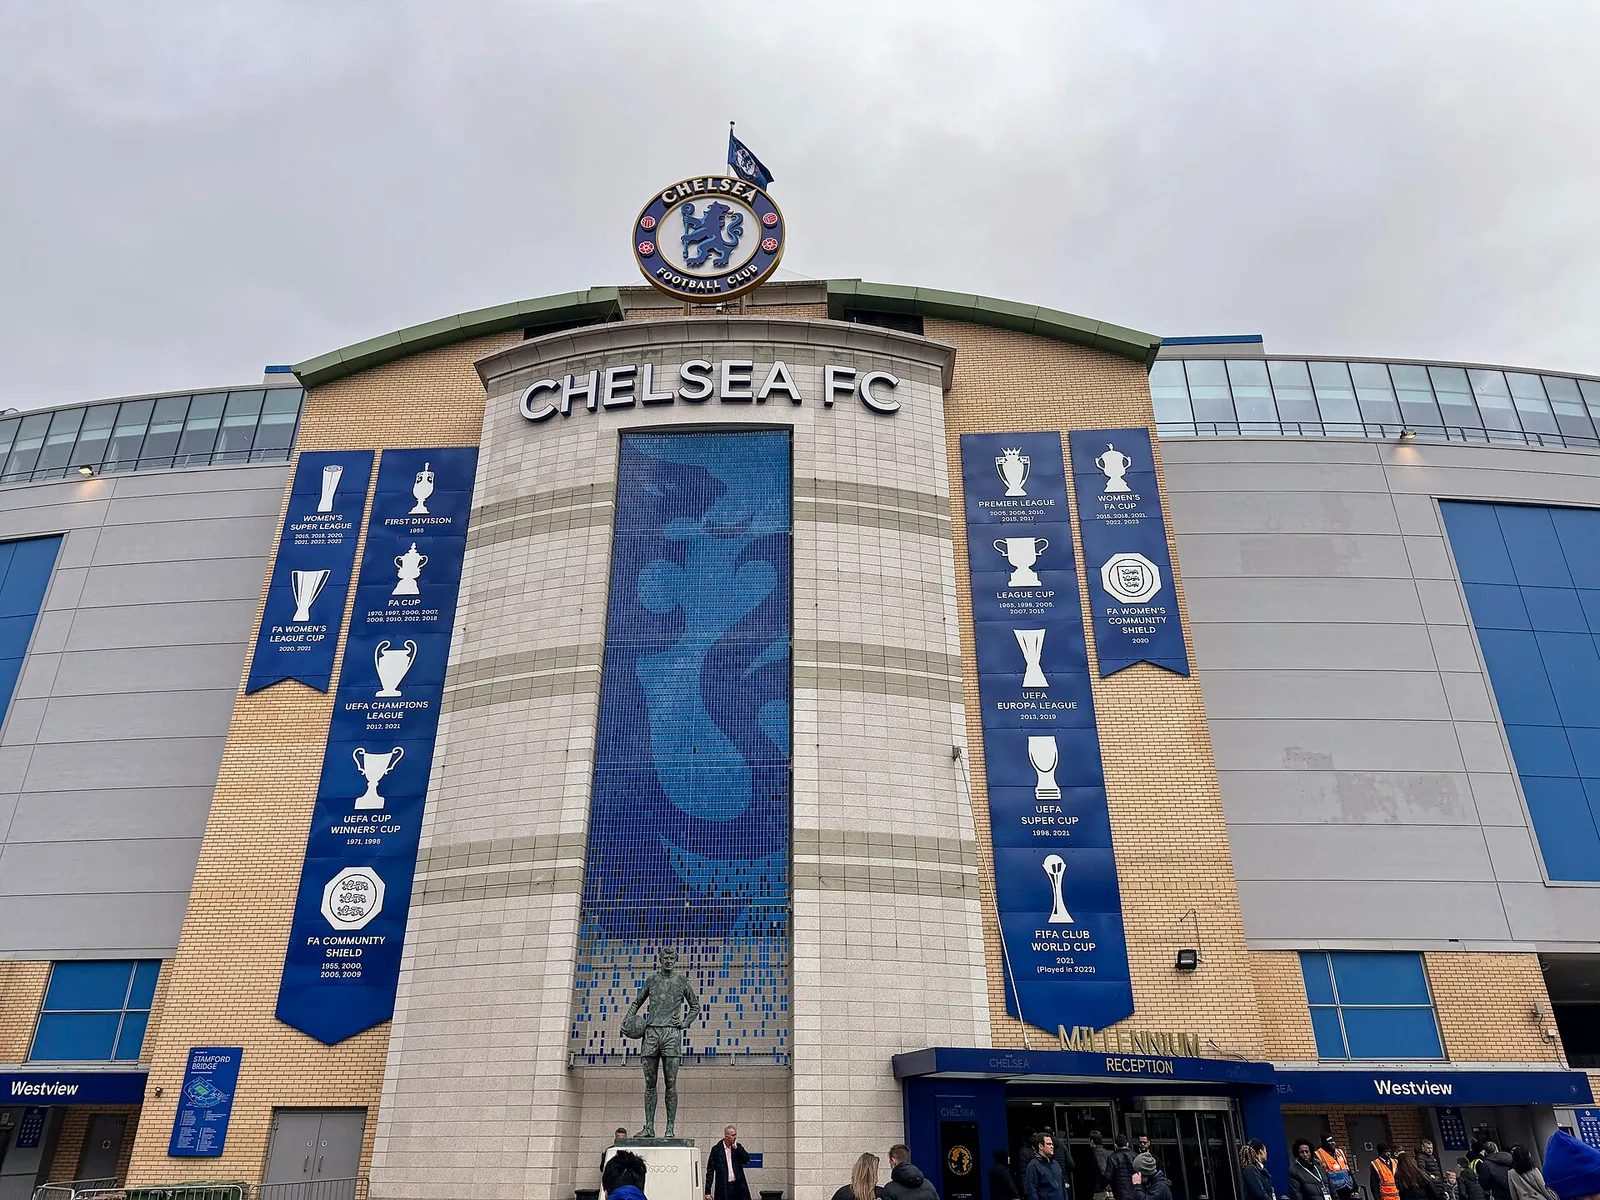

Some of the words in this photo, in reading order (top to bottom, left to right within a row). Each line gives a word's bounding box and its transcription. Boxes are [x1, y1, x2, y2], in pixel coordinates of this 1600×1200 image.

[662, 178, 758, 204] CHELSEA
[657, 267, 721, 290] FOOTBALL
[728, 265, 758, 284] CLUB
[519, 359, 803, 422] CHELSEA
[824, 364, 901, 414] FC
[372, 701, 428, 709] CHAMPIONS
[323, 937, 386, 945] COMMUNITY
[1062, 930, 1090, 938] CLUB
[326, 949, 362, 957] SHIELD
[1031, 943, 1070, 951] WORLD
[1074, 943, 1096, 951] CUP
[1058, 1025, 1200, 1058] MILLENNIUM
[990, 1058, 1030, 1068] CHELSEA
[1106, 1058, 1174, 1074] RECEPTION
[11, 1080, 79, 1096] Westview
[1374, 1079, 1452, 1095] Westview
